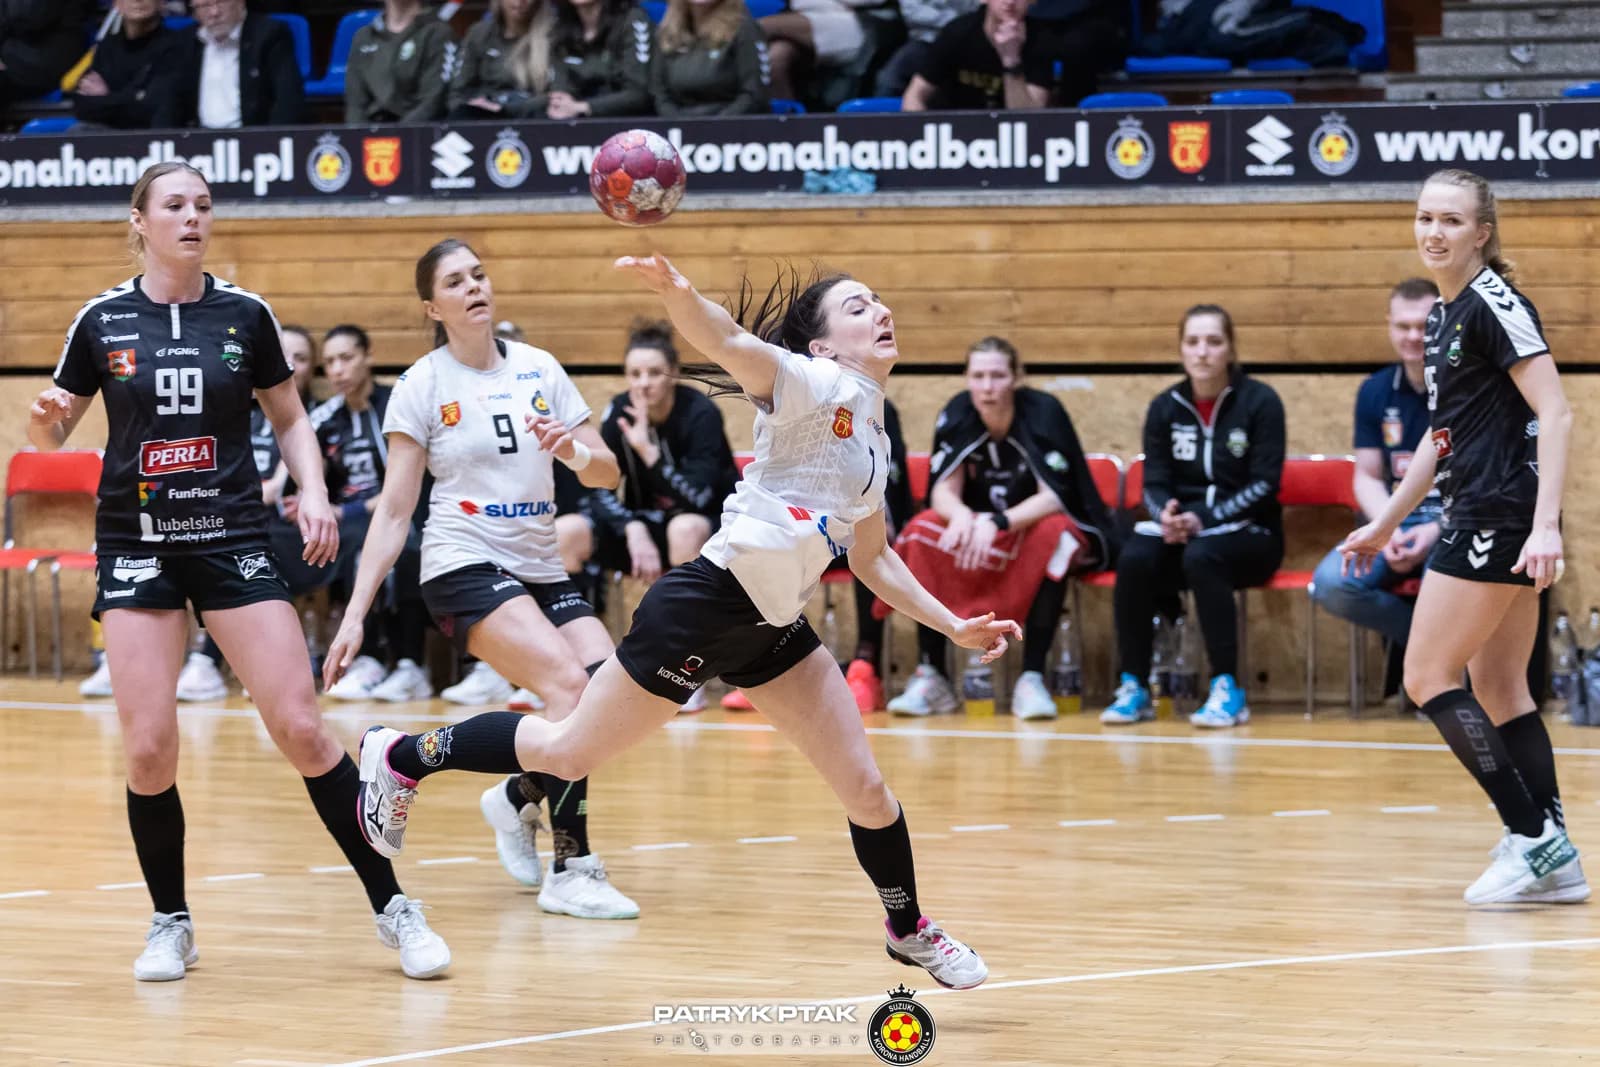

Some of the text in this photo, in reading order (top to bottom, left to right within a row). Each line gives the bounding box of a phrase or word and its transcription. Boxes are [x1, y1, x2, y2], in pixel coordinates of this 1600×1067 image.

[542, 121, 1090, 182] wkoronahandball.pl
[155, 368, 203, 415] 99
[492, 414, 518, 455] 9
[147, 444, 210, 468] PERŁA
[168, 487, 221, 499] FunFloor
[157, 515, 224, 532] lubelskie
